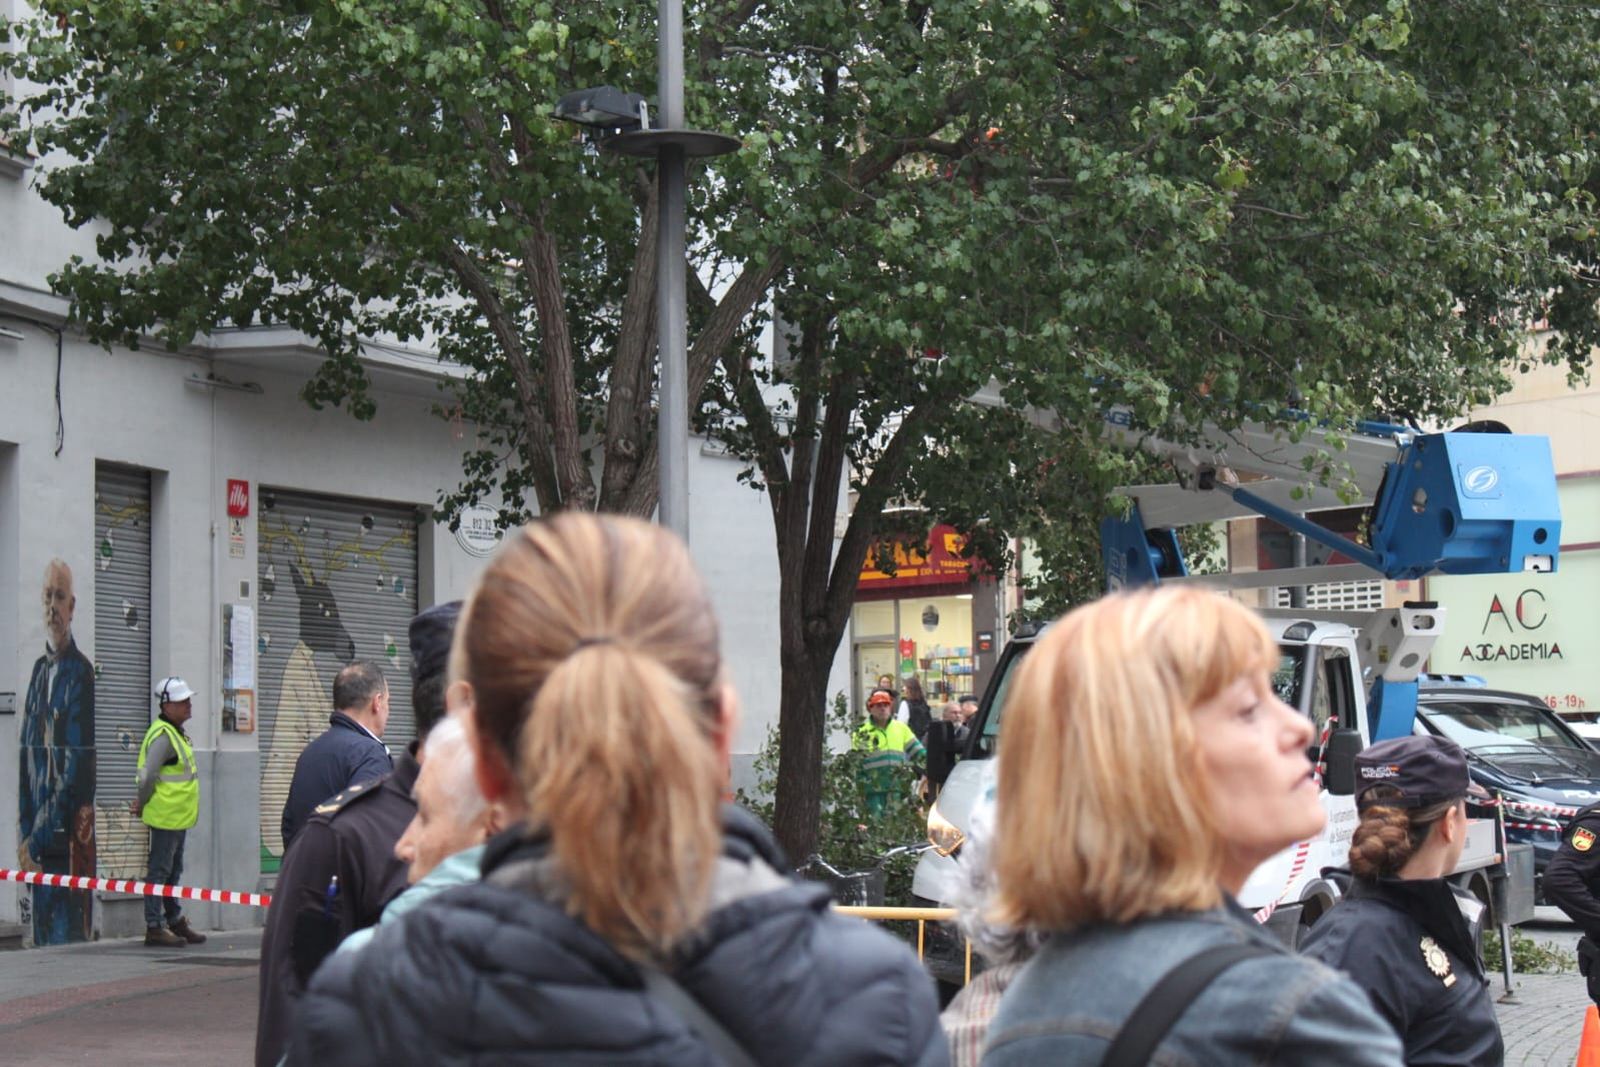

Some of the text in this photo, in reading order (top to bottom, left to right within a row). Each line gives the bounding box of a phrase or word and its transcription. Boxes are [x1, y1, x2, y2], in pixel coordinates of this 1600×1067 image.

[230, 484, 248, 512] illy
[1481, 588, 1548, 635] AC
[1460, 642, 1563, 662] ACCADEMIA
